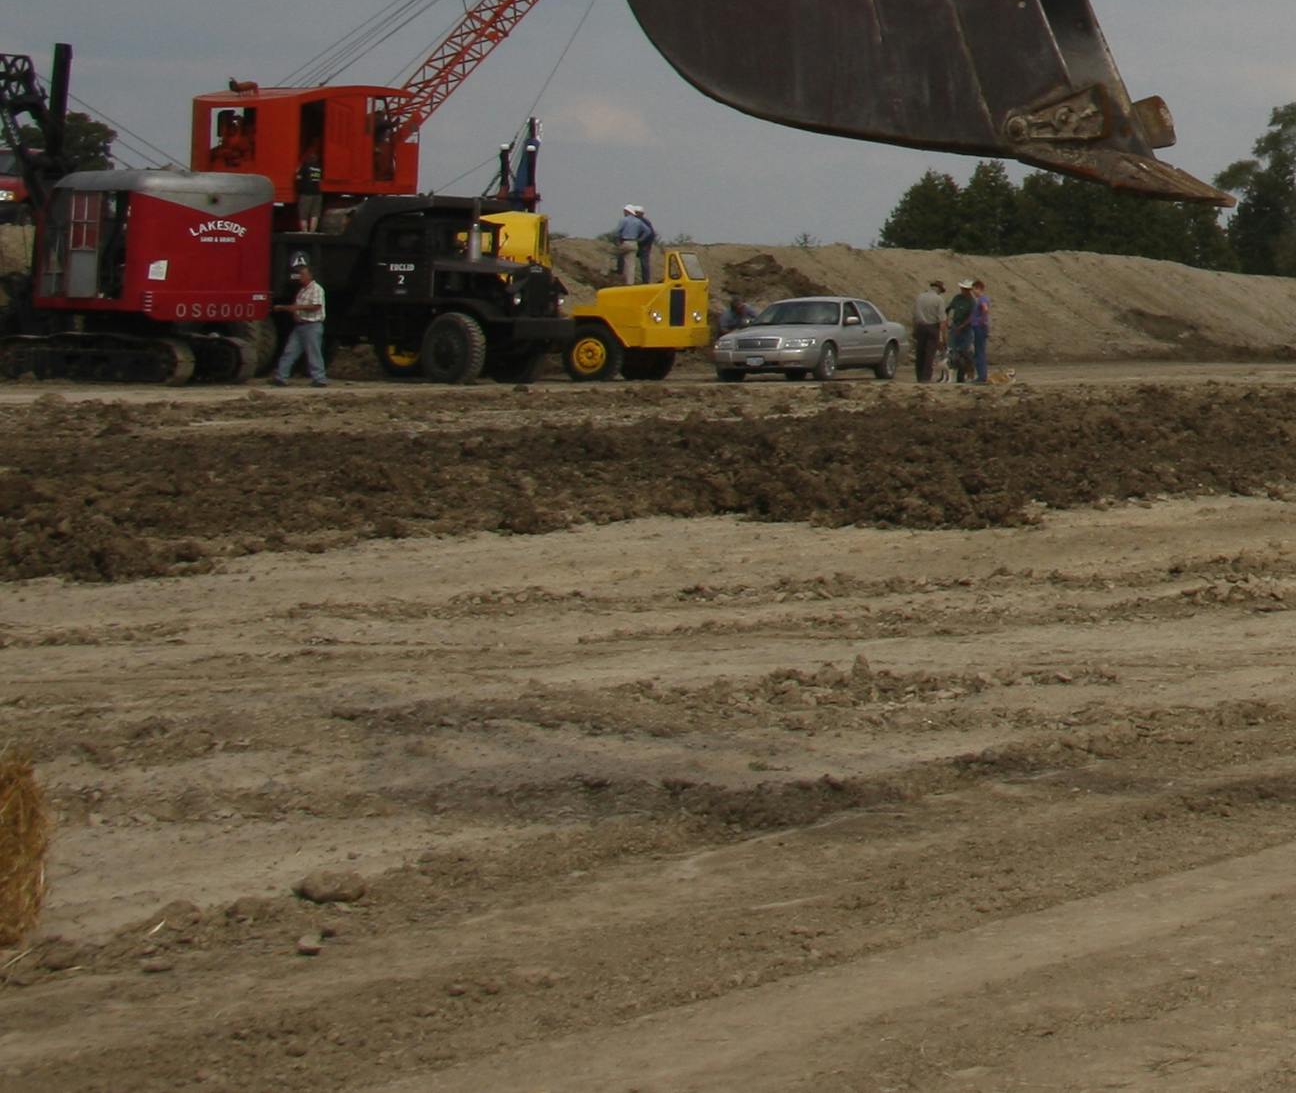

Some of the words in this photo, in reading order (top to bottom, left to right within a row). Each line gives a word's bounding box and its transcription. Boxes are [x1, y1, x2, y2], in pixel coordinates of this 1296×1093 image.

[189, 220, 247, 237] LAKESIDE
[390, 263, 415, 271] EUCLID
[398, 275, 405, 284] 2
[175, 303, 256, 318] OSGOOD
